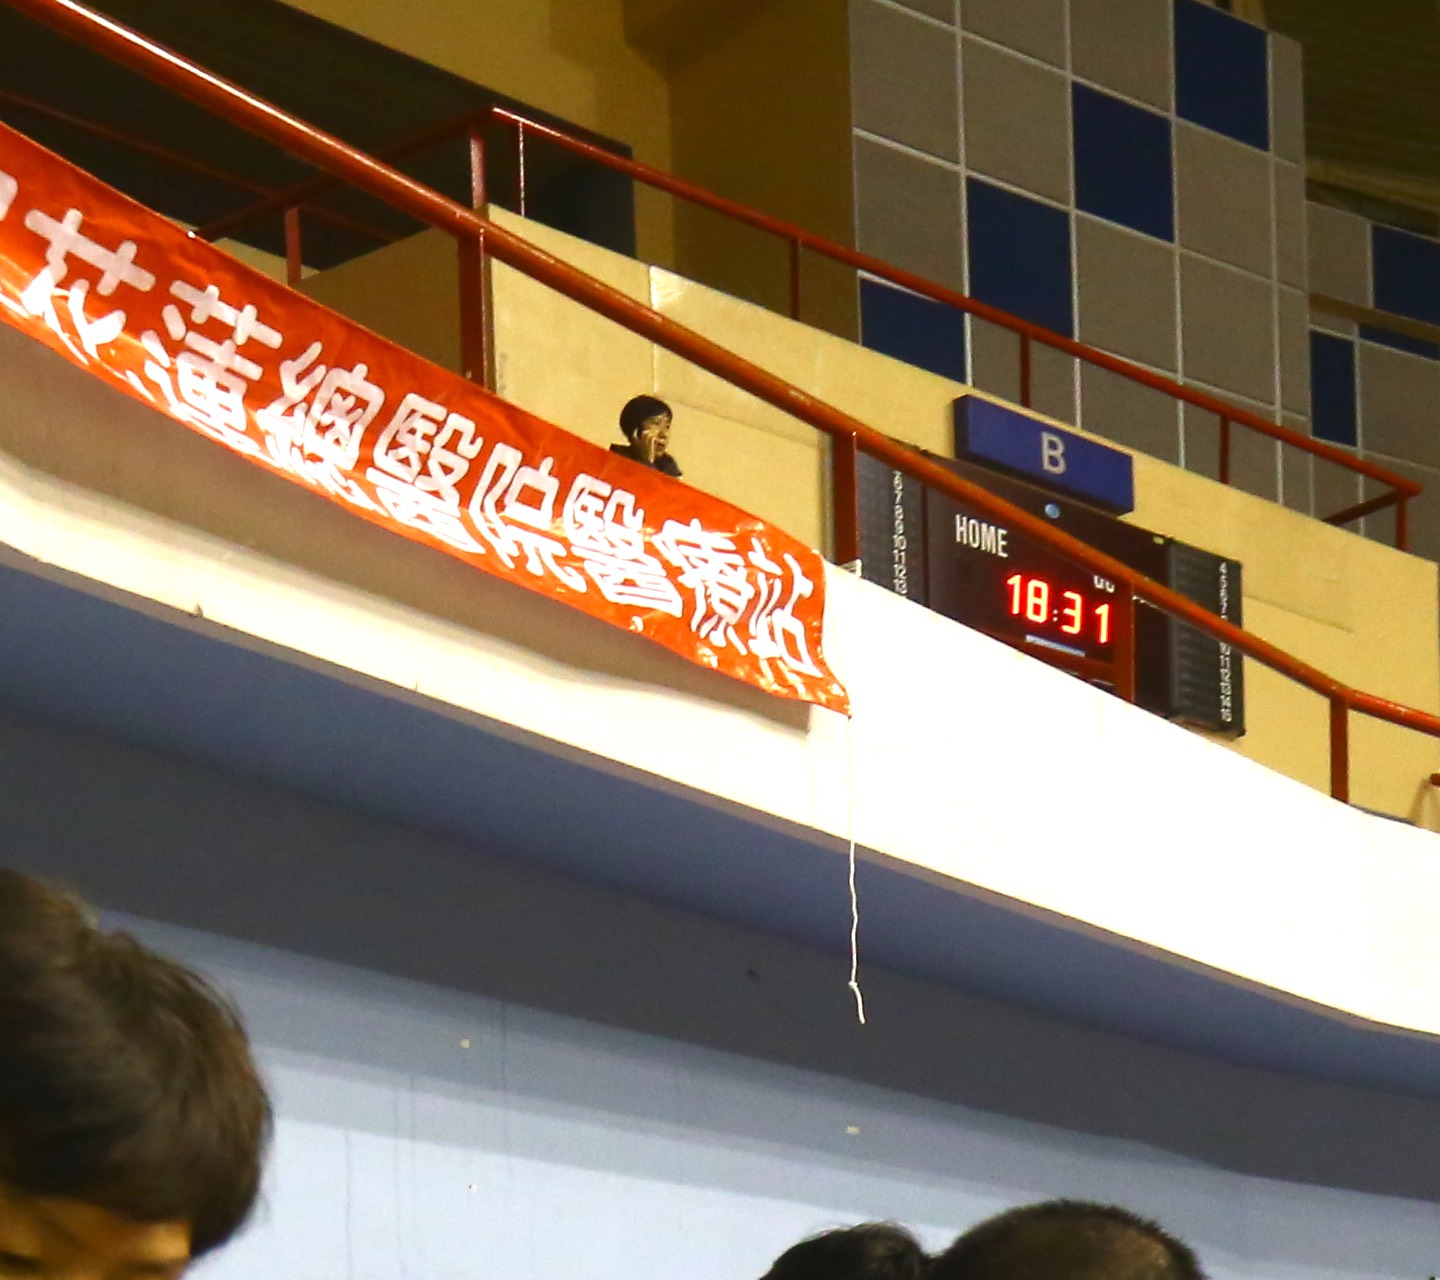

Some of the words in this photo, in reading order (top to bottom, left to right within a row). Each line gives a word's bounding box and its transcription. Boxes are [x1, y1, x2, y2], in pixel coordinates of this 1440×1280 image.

[1041, 432, 1067, 475] B
[893, 549, 905, 565] 11
[954, 514, 1009, 559] HOME
[1006, 572, 1112, 645] 18:31
